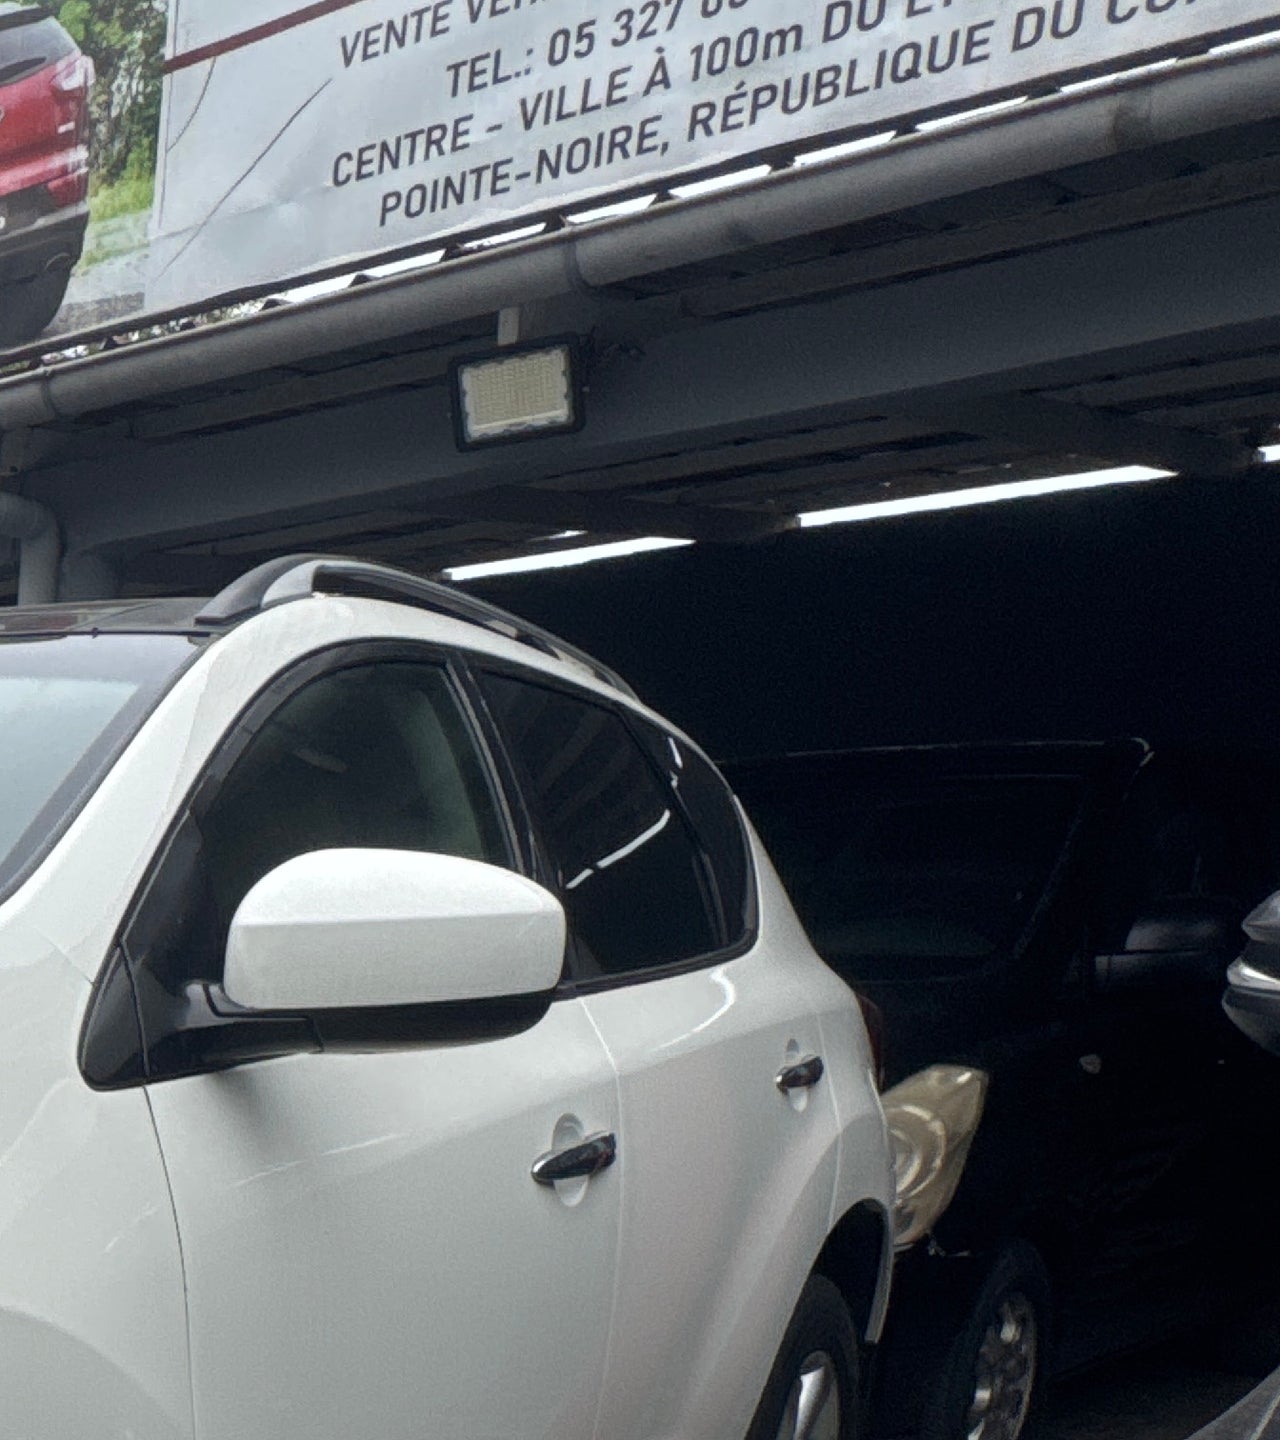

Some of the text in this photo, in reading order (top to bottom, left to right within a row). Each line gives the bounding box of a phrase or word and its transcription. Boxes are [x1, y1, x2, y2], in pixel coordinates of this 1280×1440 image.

[333, 0, 886, 187] CENTRE - VILLE À 100m DU
[339, 0, 451, 68] VENTE
[446, 0, 683, 98] TEL.: 05 327
[379, 0, 1085, 227] POINTE-NOIRE, RÉPUBLIQUE DU
